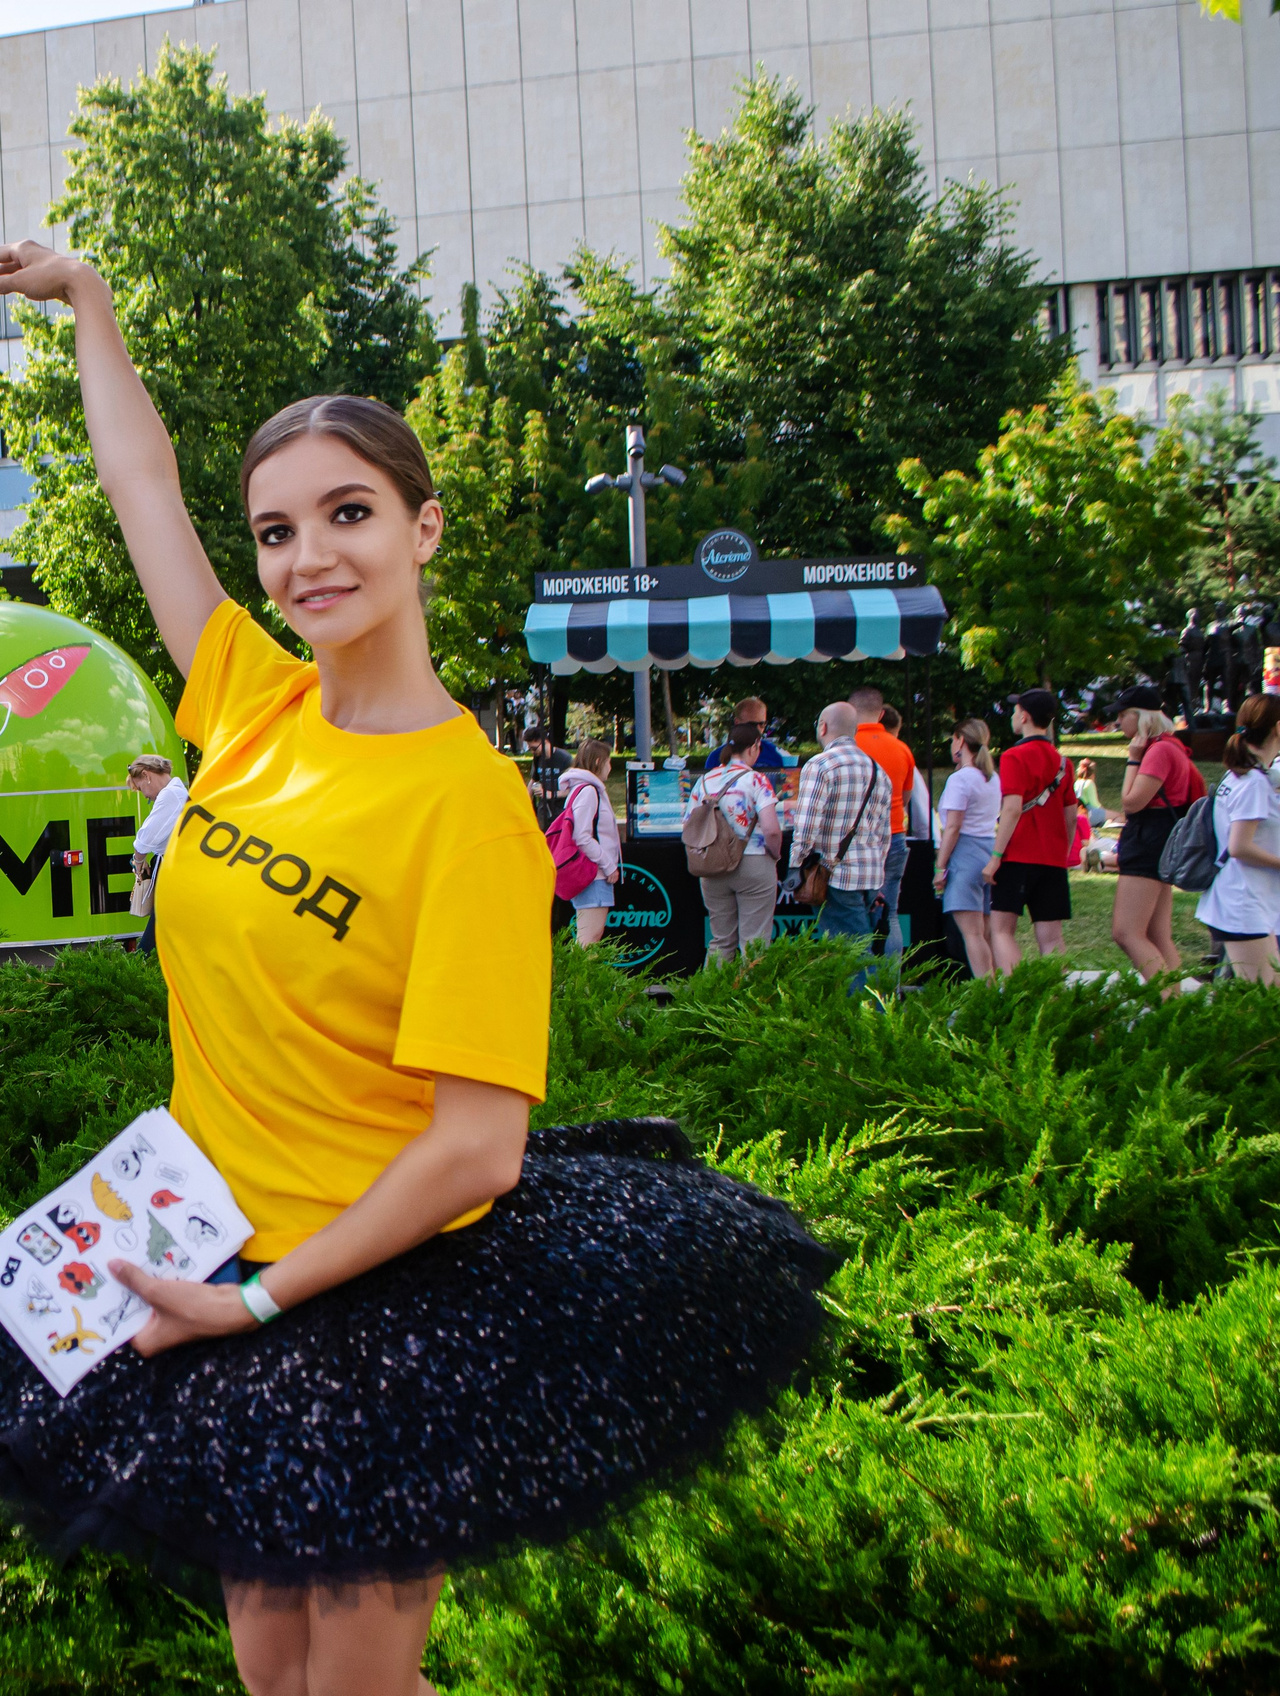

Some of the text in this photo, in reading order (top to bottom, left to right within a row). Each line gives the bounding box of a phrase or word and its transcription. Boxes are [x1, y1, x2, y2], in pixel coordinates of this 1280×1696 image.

[803, 561, 895, 584] МОРОЖЕНОЕ
[543, 574, 659, 597] МОРОЖЕНОЕ 18+
